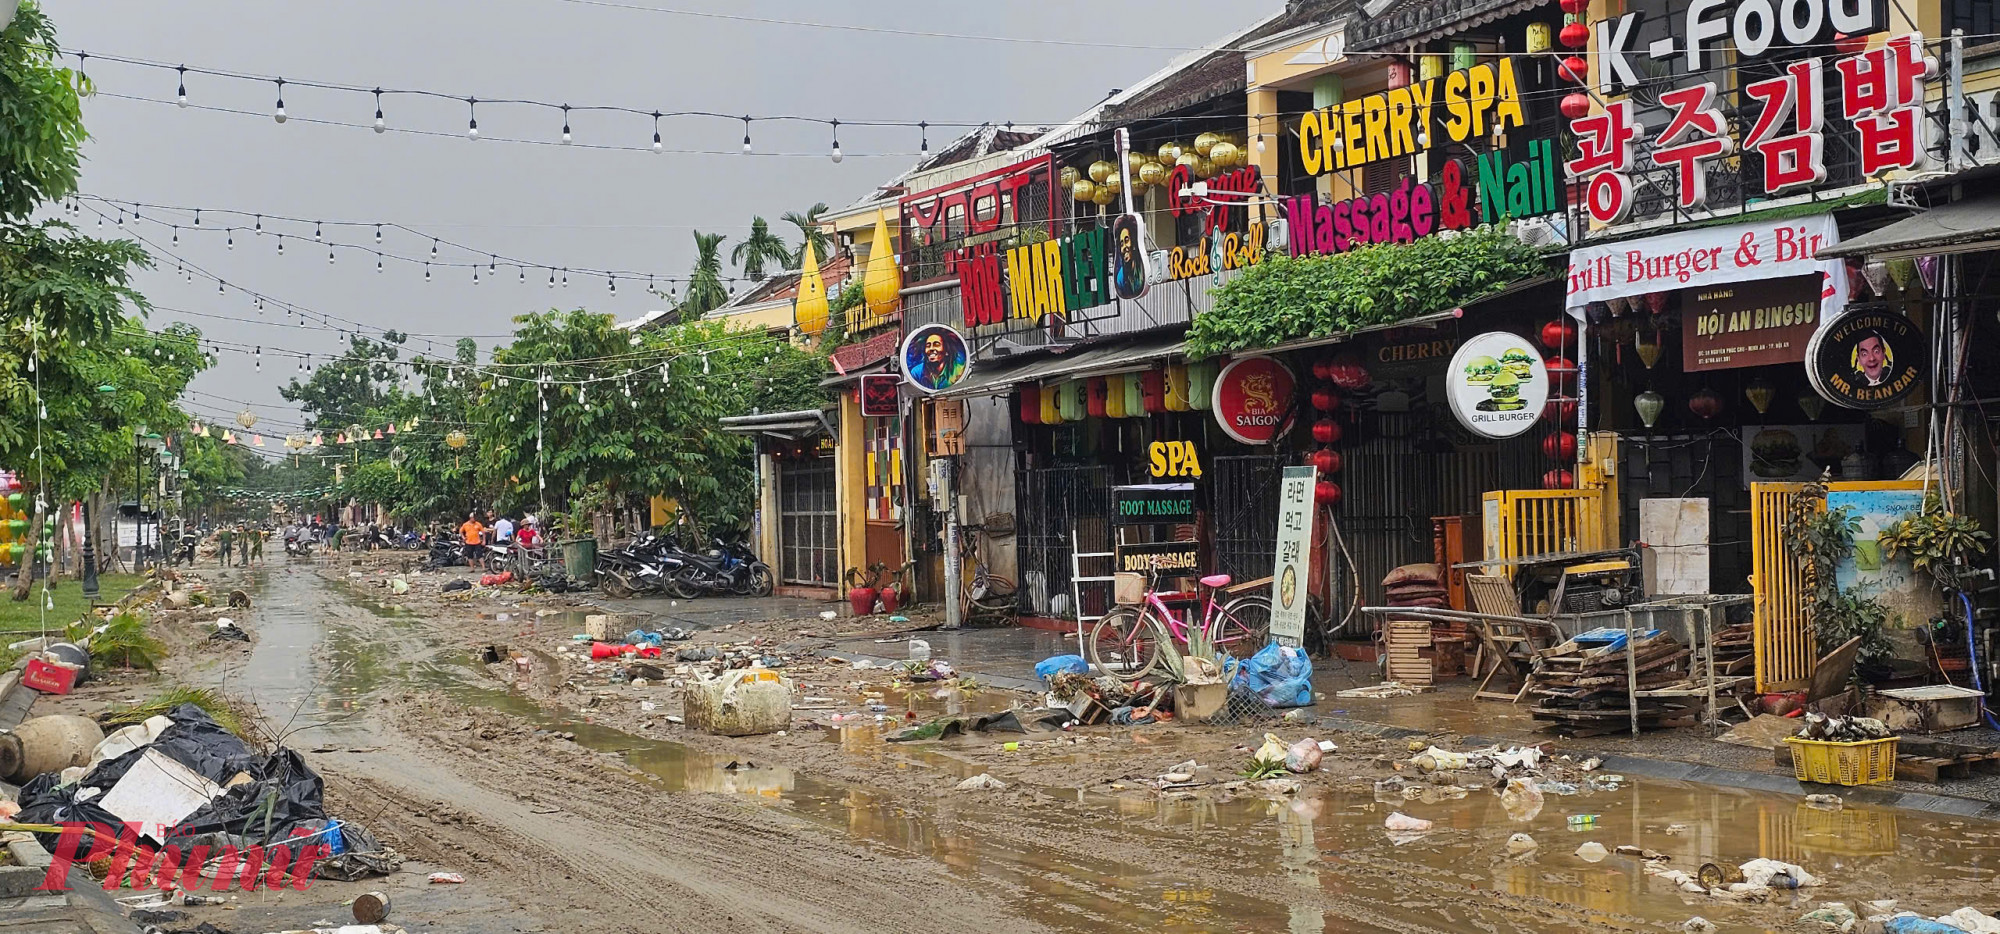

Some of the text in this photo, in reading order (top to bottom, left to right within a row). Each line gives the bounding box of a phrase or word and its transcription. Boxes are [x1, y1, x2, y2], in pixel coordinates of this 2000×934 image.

[1300, 57, 1525, 176] CHERRY SPA
[1569, 32, 1932, 224] 광주김밥
[1287, 139, 1557, 259] Massage & Nail
[1170, 237, 1210, 281] Rock
[1626, 245, 1723, 283] Burger
[1734, 231, 1762, 268] &
[957, 227, 1107, 328] BOB MARLEY
[1697, 302, 1815, 340] HỘI AN BINGSU
[1833, 317, 1907, 342] WELCOME TO
[1378, 339, 1458, 363] CHERRY
[1829, 366, 1918, 400] MR. BEAN BAR
[1236, 415, 1281, 426] SAIGON
[1471, 412, 1535, 423] GRILL BURGER
[1149, 440, 1202, 477] SPA
[1287, 481, 1305, 503] 라면
[1119, 499, 1192, 516] FOOT MASSAGE
[1285, 510, 1302, 533] 먹고
[1124, 551, 1197, 572] BODY SSAGE
[1283, 541, 1300, 563] 갈래
